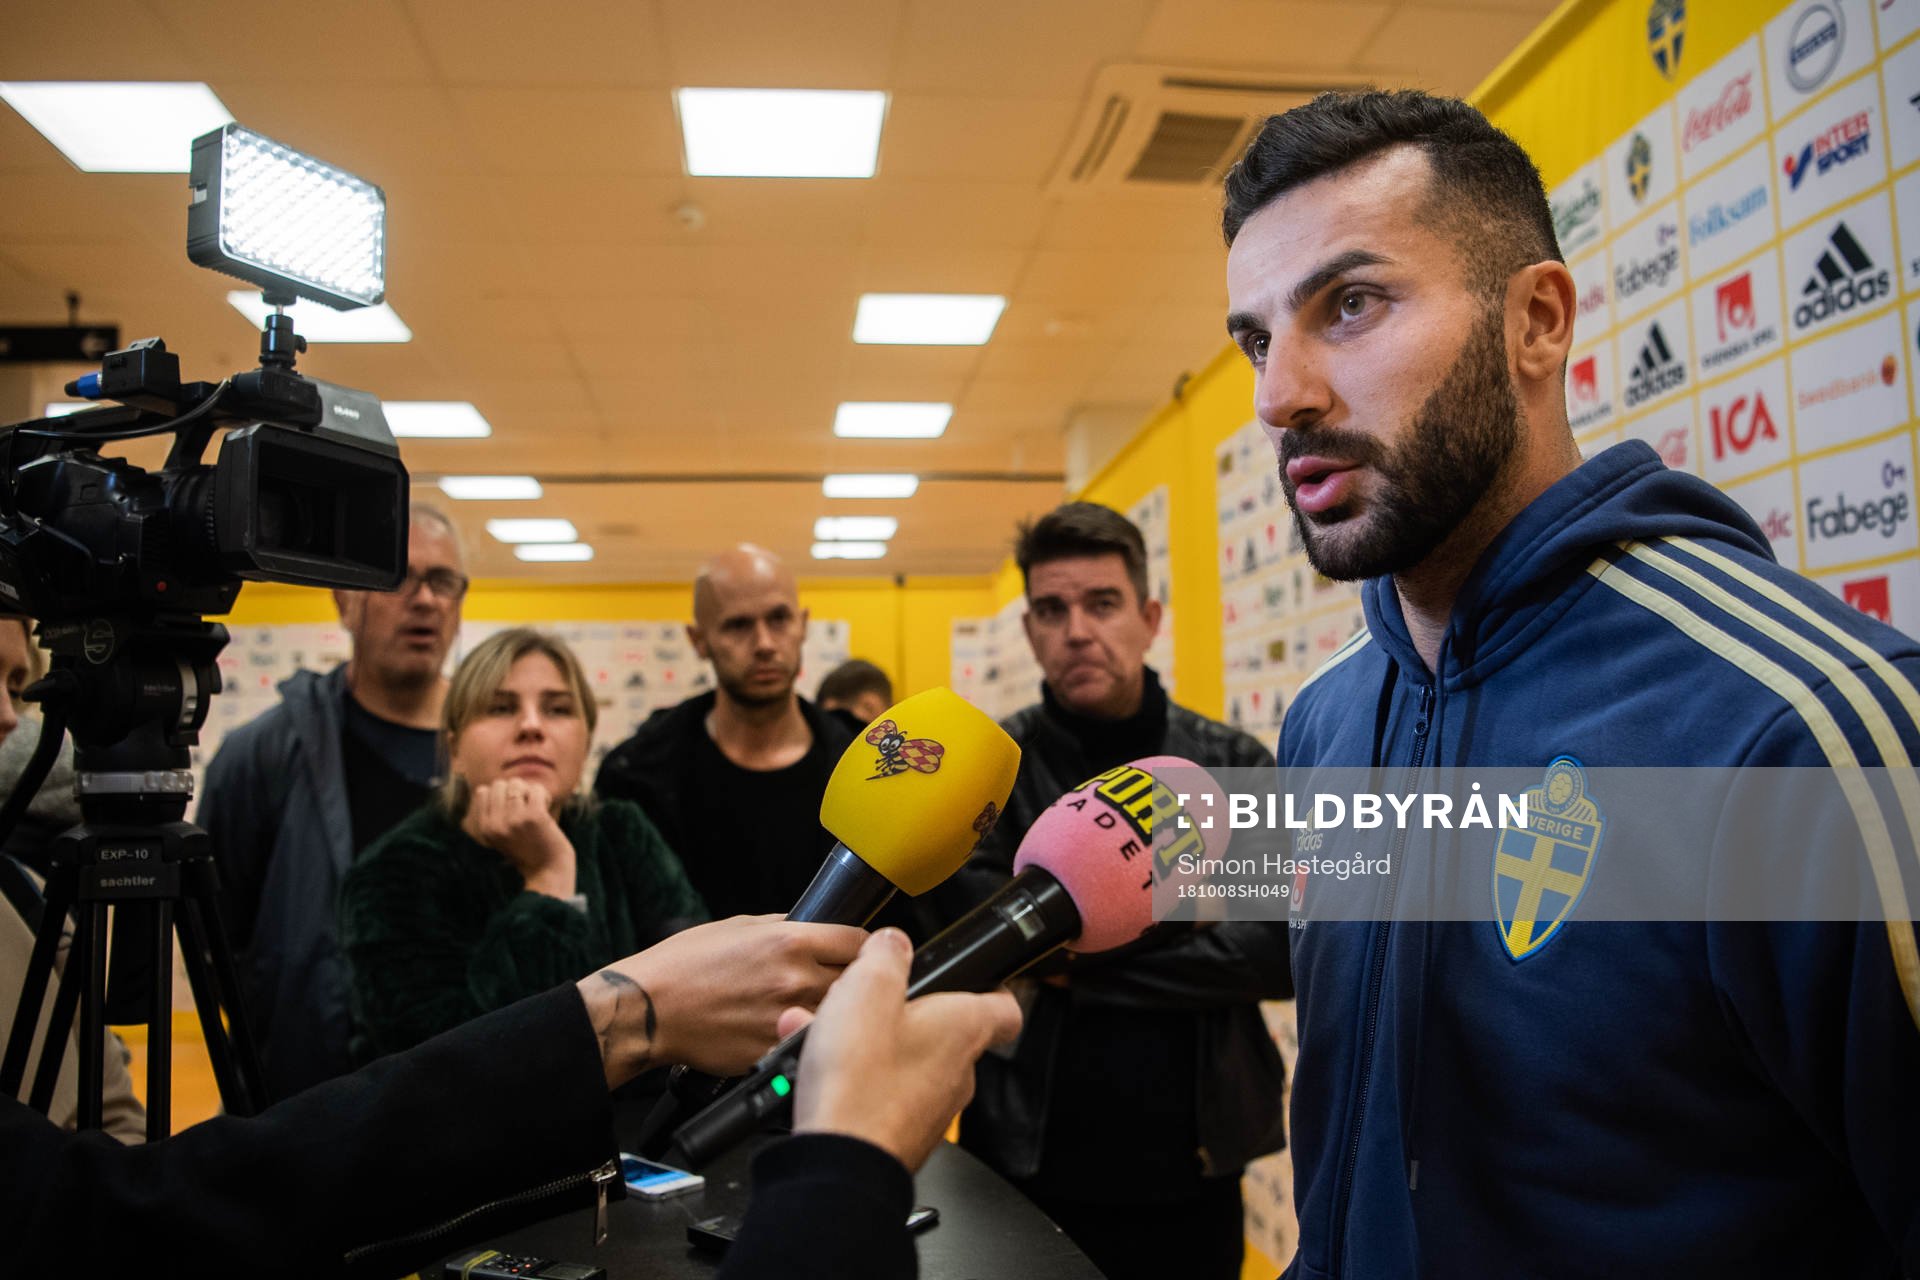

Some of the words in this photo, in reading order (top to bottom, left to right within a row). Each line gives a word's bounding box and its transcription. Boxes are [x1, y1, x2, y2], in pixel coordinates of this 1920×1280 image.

[1794, 270, 1890, 330] adidas
[1709, 389, 1778, 462] ICA
[1806, 491, 1909, 542] Fabege
[1526, 814, 1584, 840] VERIGE
[100, 849, 149, 860] EXP-10
[100, 875, 156, 887] sachtler
